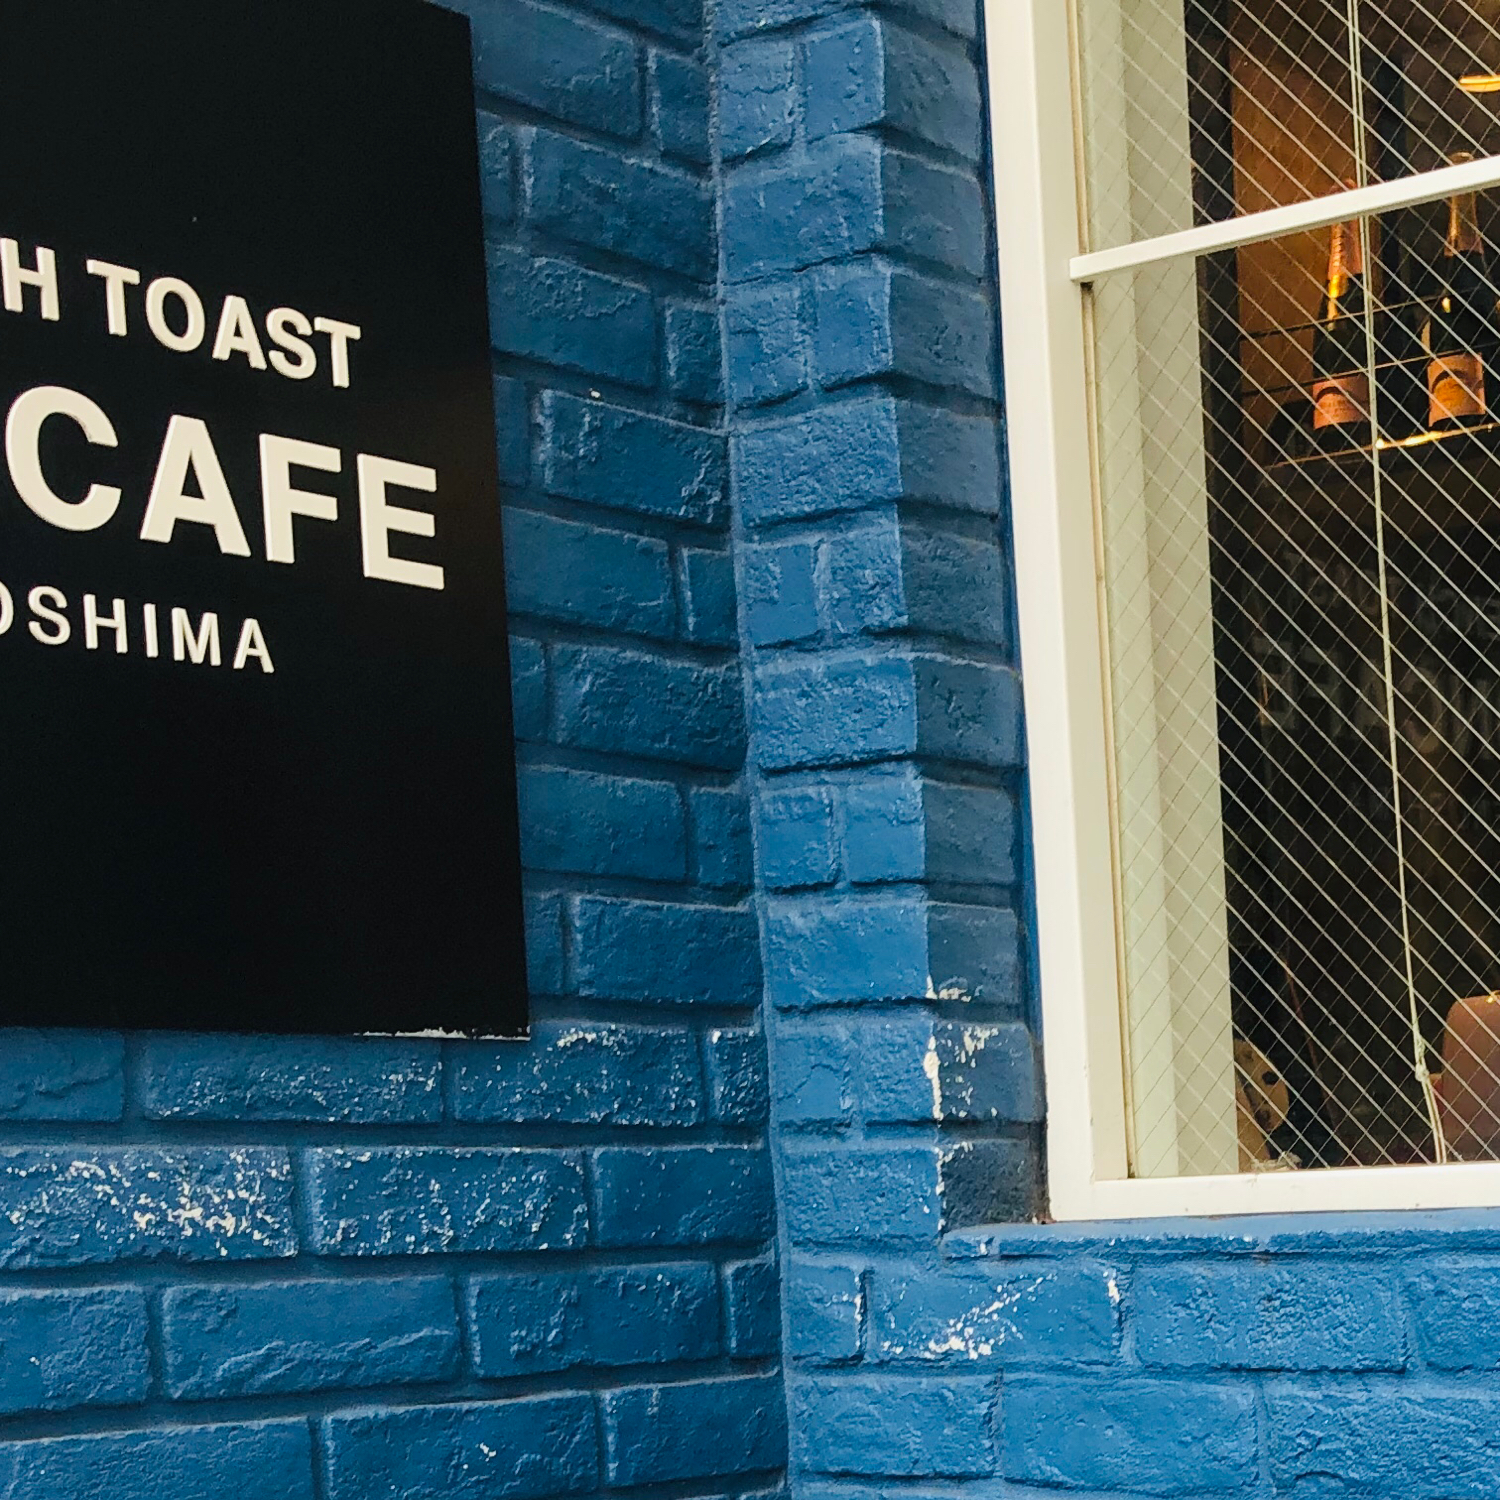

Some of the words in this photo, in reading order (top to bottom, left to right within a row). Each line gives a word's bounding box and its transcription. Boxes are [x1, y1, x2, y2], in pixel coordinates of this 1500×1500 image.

[0, 238, 59, 321] H
[87, 259, 361, 388] TOAST
[6, 386, 444, 589] CAFE
